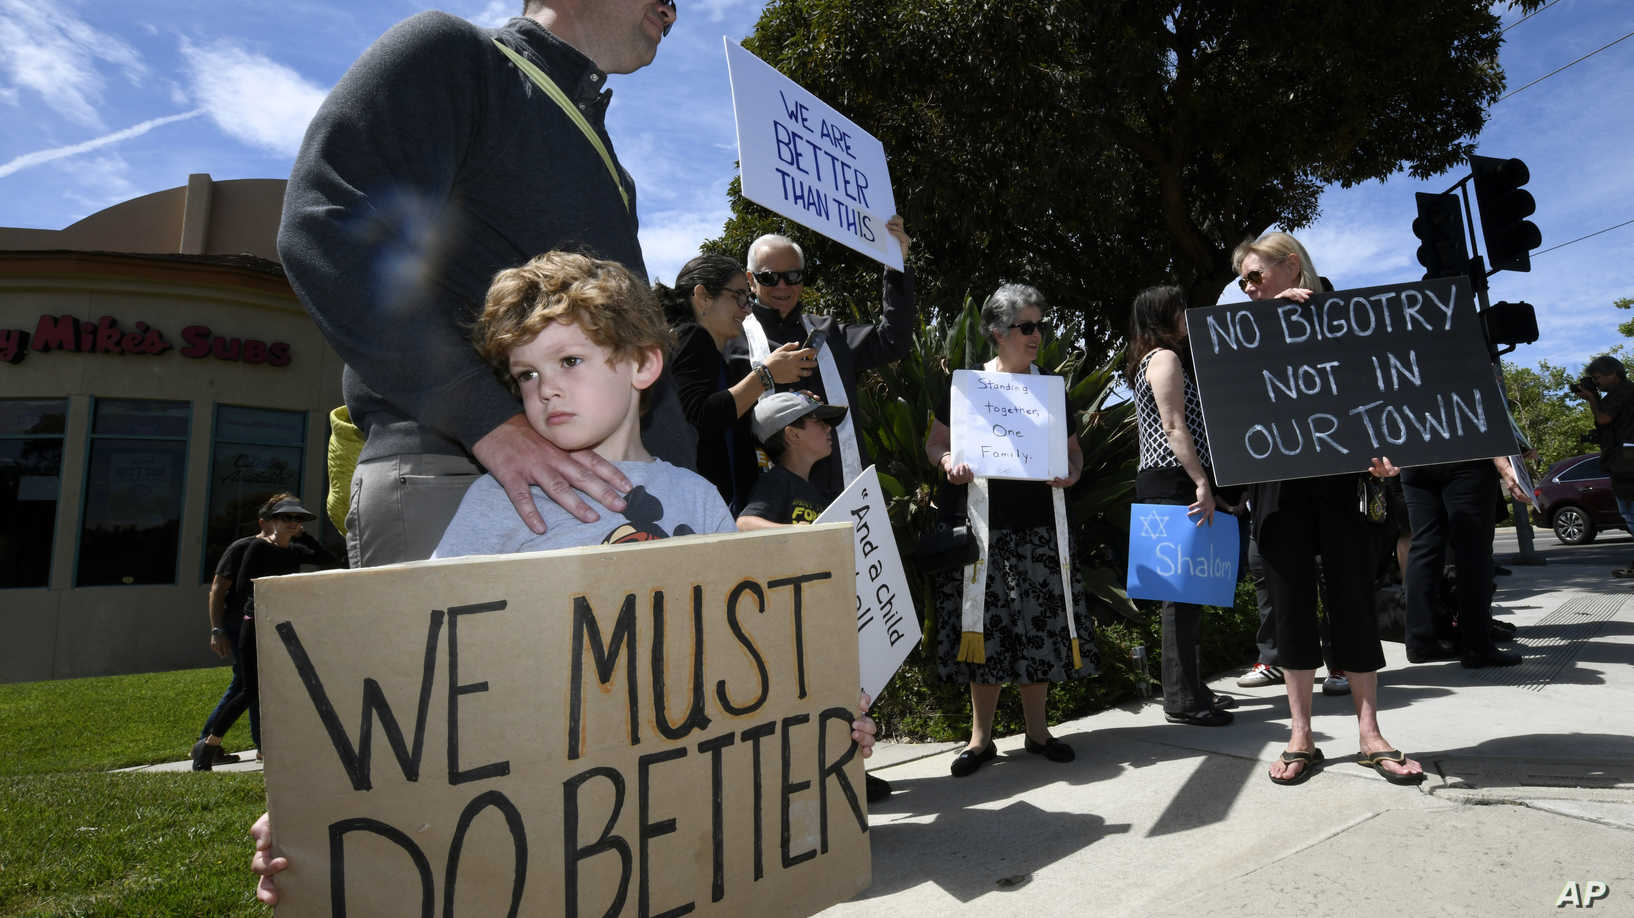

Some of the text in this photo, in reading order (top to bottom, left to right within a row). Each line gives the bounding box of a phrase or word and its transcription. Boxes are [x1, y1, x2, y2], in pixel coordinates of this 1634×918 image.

[779, 89, 856, 160] WE ARE
[773, 119, 870, 209] BETTER
[775, 167, 876, 242] THAN THIS
[31, 314, 170, 354] Mike's
[1206, 284, 1456, 354] NO BIGOTRY
[976, 377, 1029, 395] Standing
[1262, 349, 1422, 403] NOT IN
[992, 423, 1024, 438] One
[1245, 388, 1487, 460] OUR TOWN
[1155, 541, 1232, 579] Shalom
[869, 559, 883, 582] a
[876, 583, 905, 648] child
[274, 569, 833, 792] WE MUST
[328, 706, 869, 918] DO BETTER
